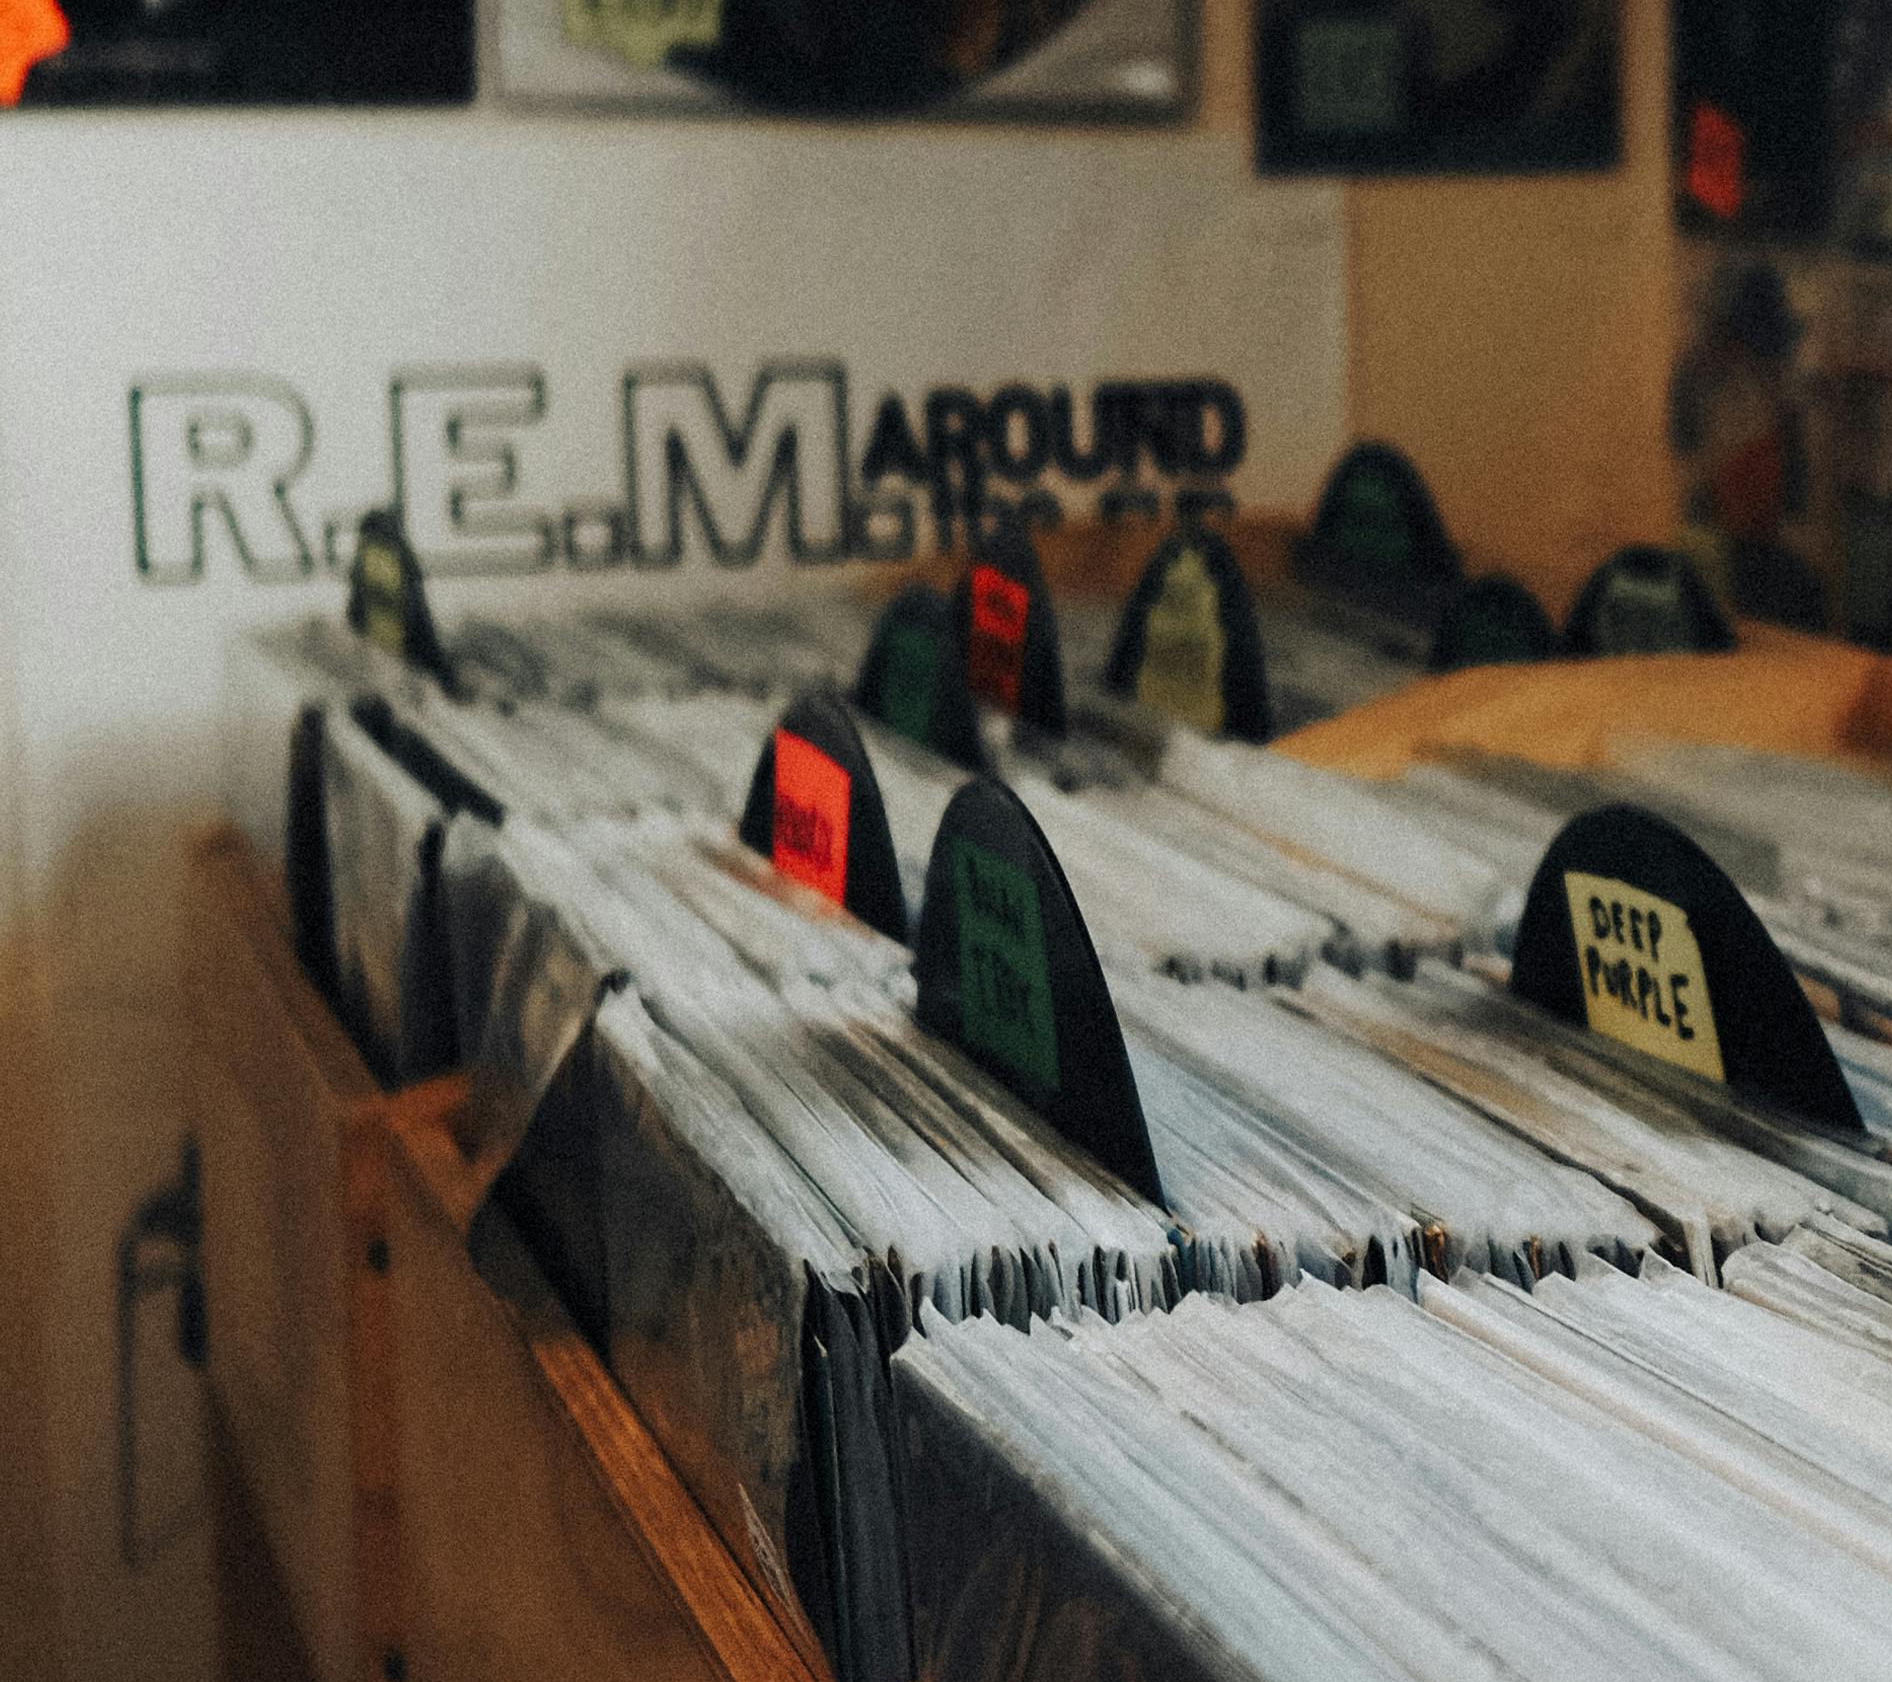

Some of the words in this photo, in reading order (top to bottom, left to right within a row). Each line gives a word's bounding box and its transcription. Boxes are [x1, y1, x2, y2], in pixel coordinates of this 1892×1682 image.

[861, 376, 1246, 483] AROUND
[1588, 895, 1663, 962] DEEP
[1586, 946, 1695, 1040] PURPLE
